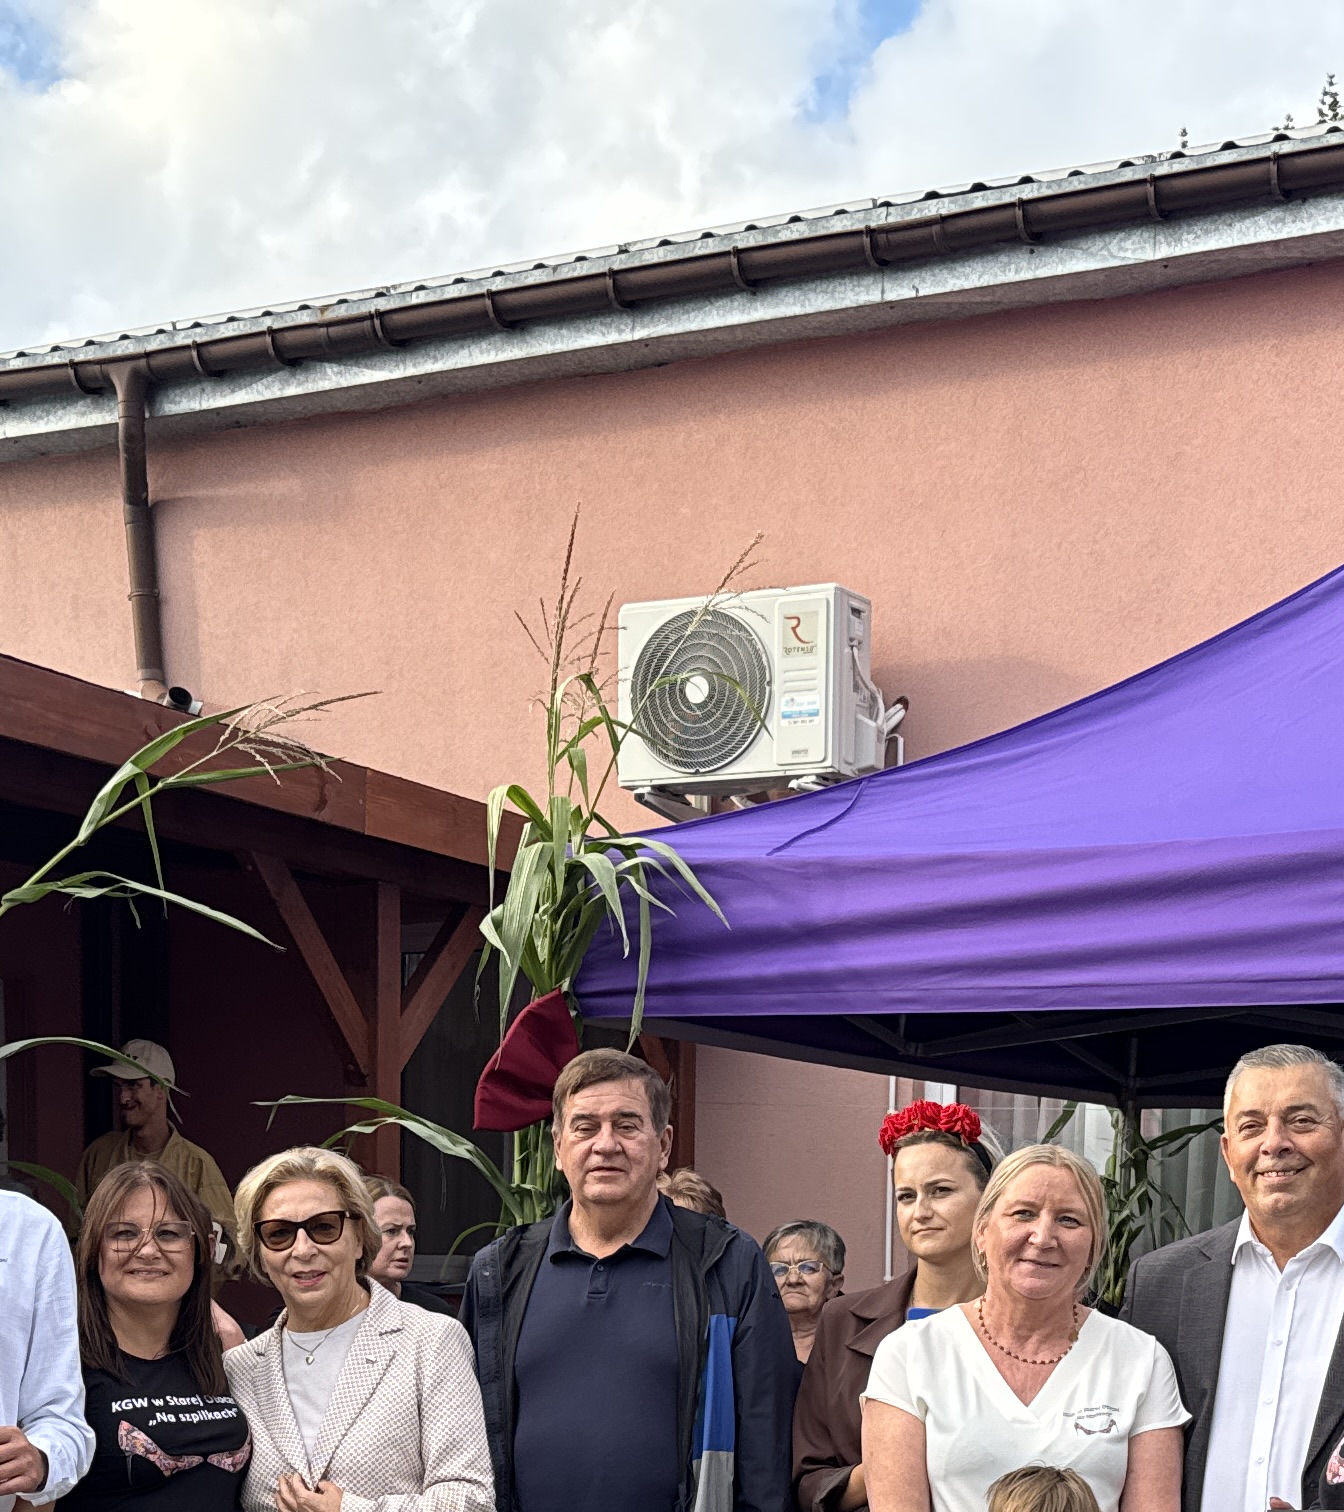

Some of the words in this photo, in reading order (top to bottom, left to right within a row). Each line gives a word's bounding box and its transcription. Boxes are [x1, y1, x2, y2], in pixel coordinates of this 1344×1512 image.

[111, 1396, 148, 1413] KGW
[151, 1398, 164, 1407] w
[166, 1393, 204, 1407] Starej
